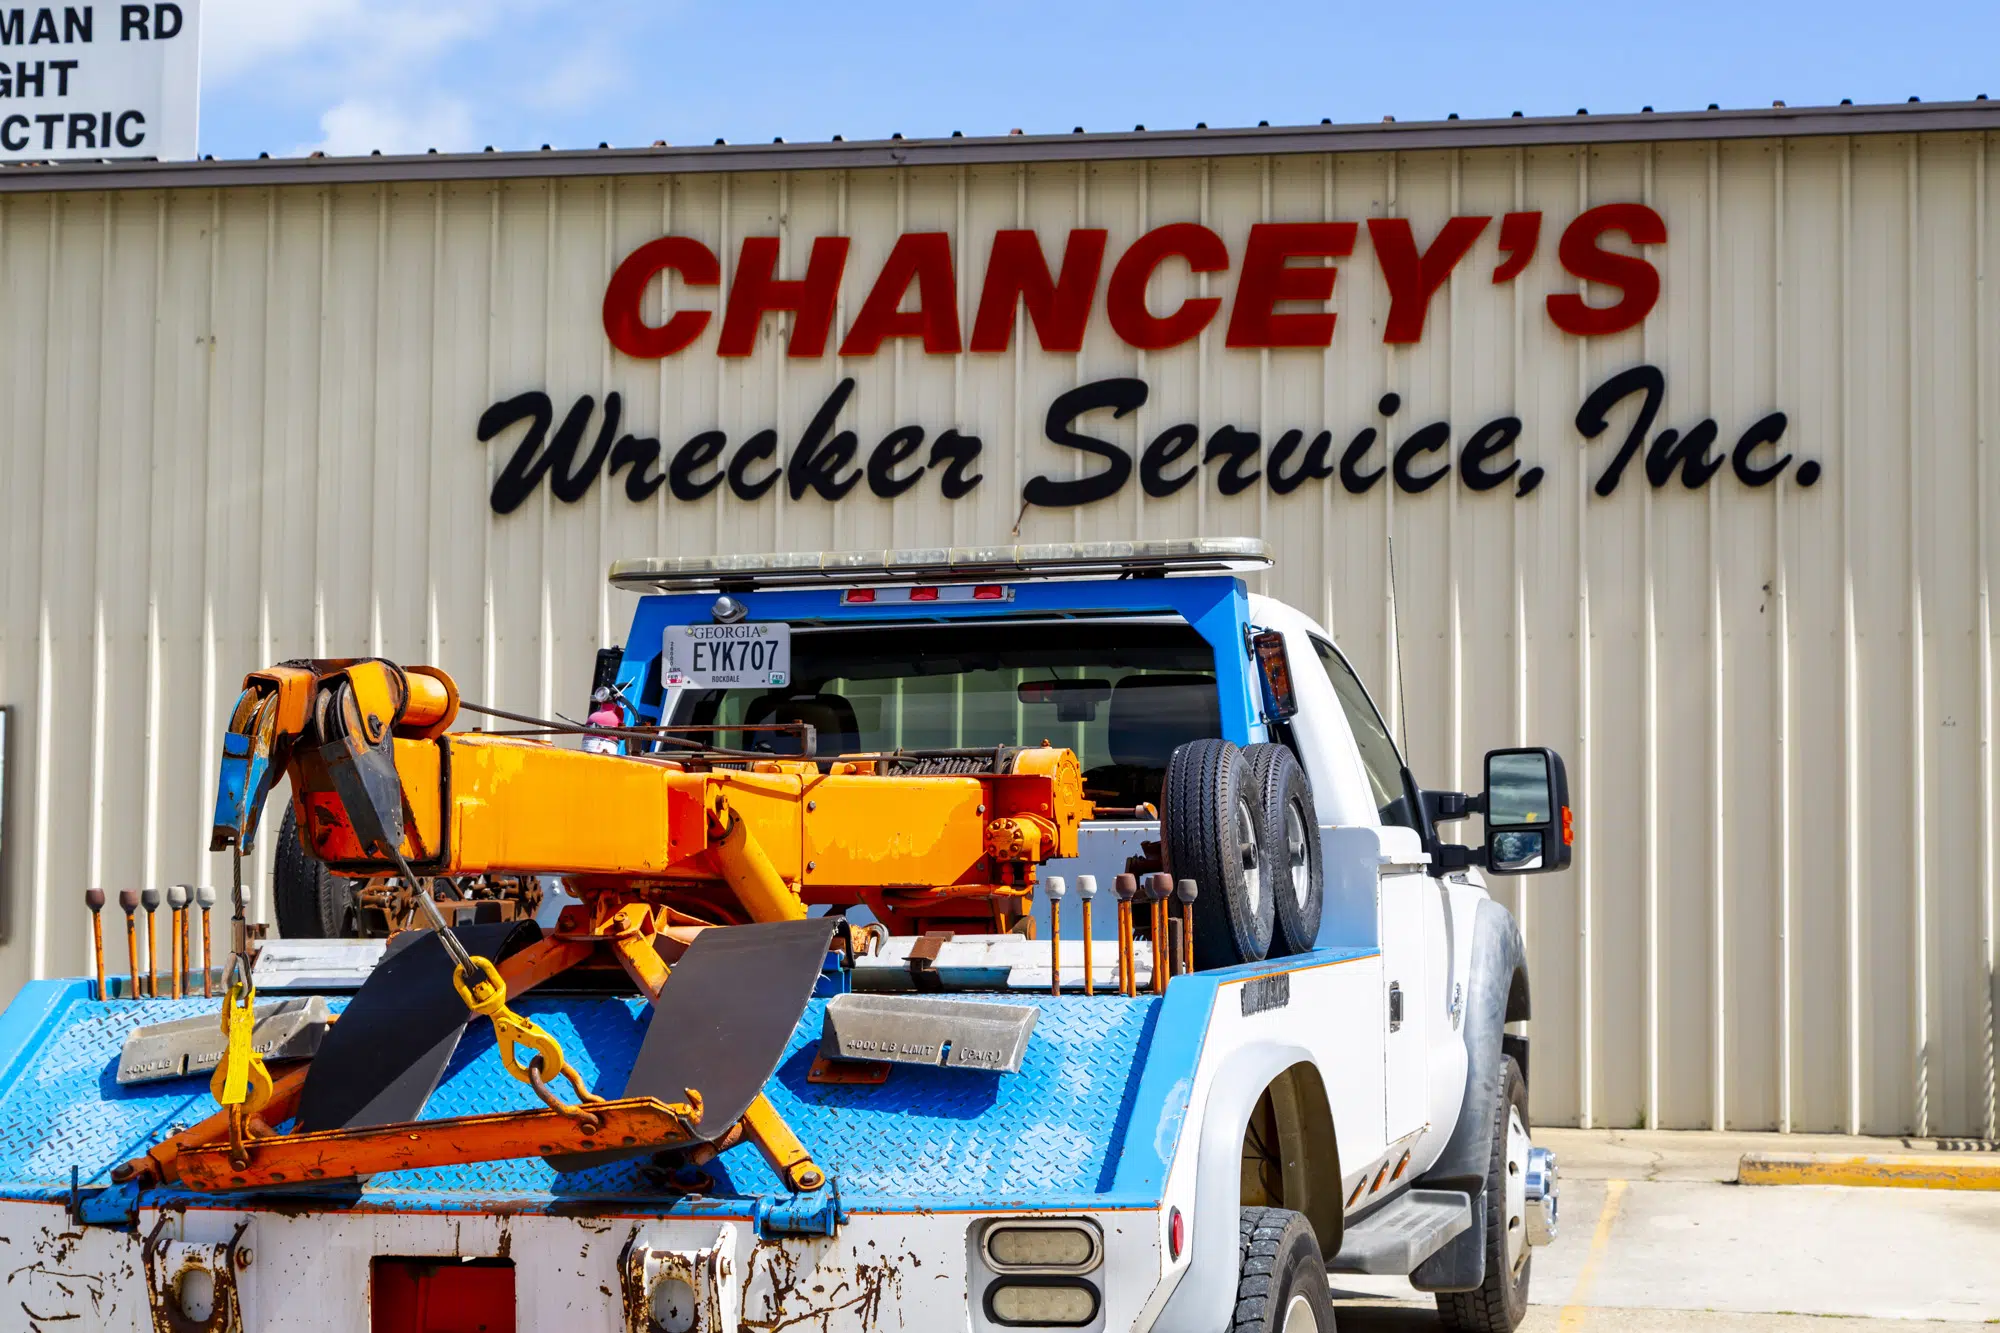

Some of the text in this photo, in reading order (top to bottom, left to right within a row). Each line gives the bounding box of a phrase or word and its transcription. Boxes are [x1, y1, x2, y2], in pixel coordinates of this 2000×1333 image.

[0, 3, 183, 45] MAN RD
[0, 110, 146, 151] CTRIC
[603, 203, 1667, 358] CHANCEY'S
[477, 365, 1822, 514] Wrecker Service, Inc.
[694, 626, 761, 639] GEORGIA
[693, 640, 779, 671] EYK707
[711, 675, 740, 683] ROCKDALE
[847, 1039, 1002, 1063] 4000 LB LIMIT (PAIR)
[125, 1061, 153, 1075] 4000
[157, 1060, 171, 1070] LB
